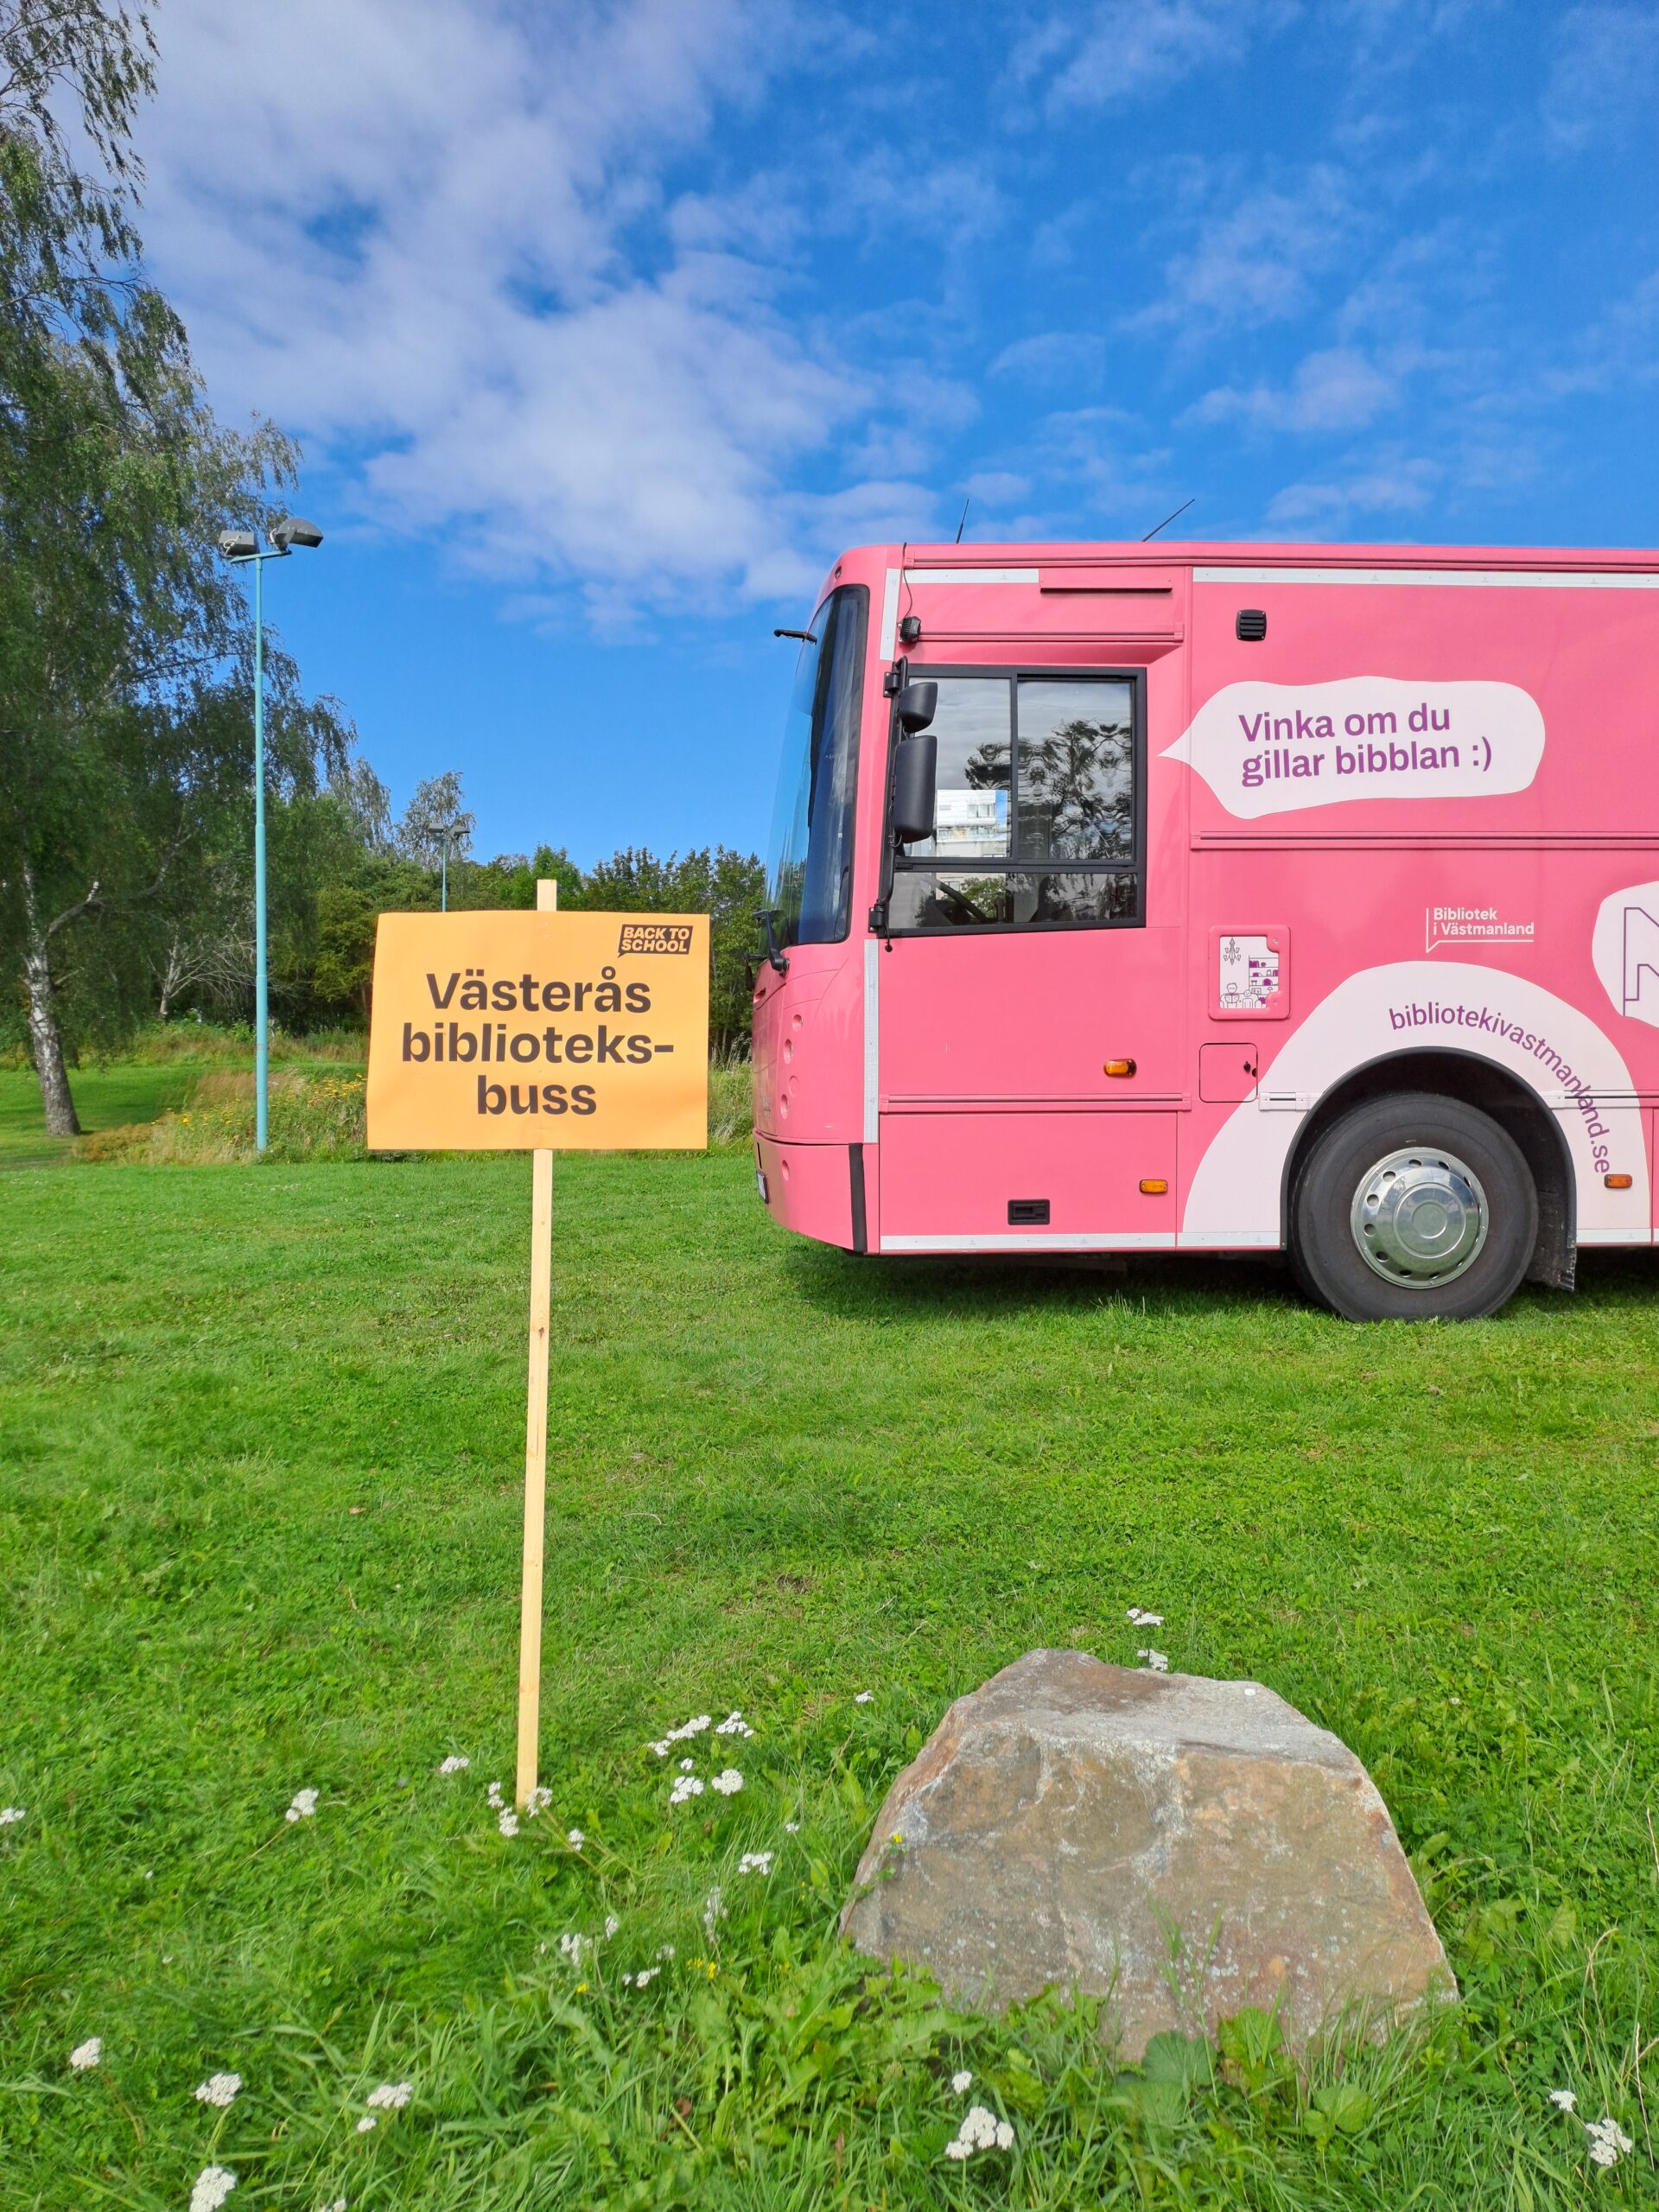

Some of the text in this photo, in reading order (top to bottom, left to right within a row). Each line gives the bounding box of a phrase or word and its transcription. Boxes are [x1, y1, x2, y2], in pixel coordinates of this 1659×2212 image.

[1238, 702, 1451, 742] Vinka om du
[1242, 736, 1492, 788] gillar bibblan :)
[623, 926, 690, 940] BACK TO
[1433, 907, 1497, 920] Bibliotek
[1433, 922, 1535, 936] i Västmanland
[621, 938, 688, 952] SCHOOL
[426, 965, 652, 1014] Västerås
[402, 1022, 675, 1065] biblioteks-
[476, 1074, 597, 1116] buss
[1388, 1001, 1611, 1174] bibliotekivastmanland.se
